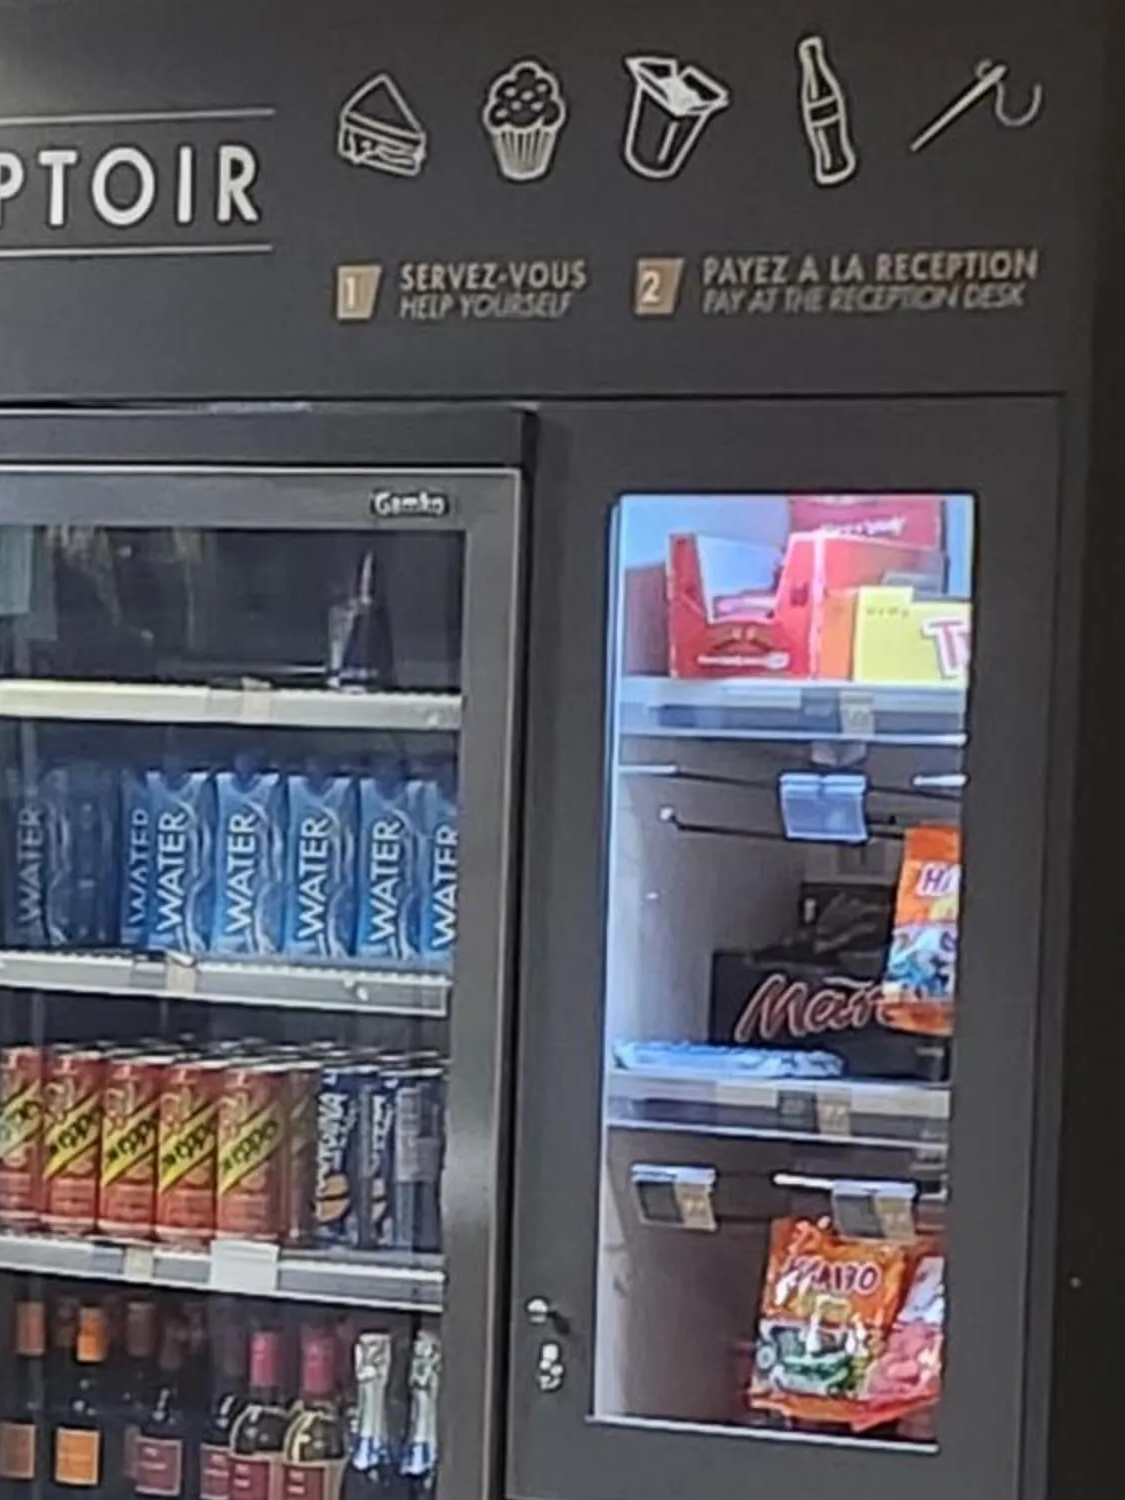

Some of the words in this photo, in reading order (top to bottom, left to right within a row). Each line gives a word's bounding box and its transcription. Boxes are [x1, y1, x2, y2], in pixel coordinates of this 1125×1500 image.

[401, 260, 586, 291] SERVEZ-VOUS
[637, 271, 661, 304] 2
[702, 257, 790, 285] PAYEZ
[797, 255, 821, 283] A
[829, 253, 865, 283] LA
[877, 249, 1039, 282] RECEPTION
[702, 288, 744, 314] PAY
[746, 286, 775, 313] AT
[783, 286, 823, 313] THE
[828, 284, 962, 312] RECEPTION
[962, 282, 1028, 310] DESK
[399, 294, 455, 319] HELP
[459, 292, 573, 319] YOURSELF
[17, 808, 42, 923] WATER
[154, 811, 187, 932] WATER
[225, 813, 255, 933] WATER
[297, 818, 328, 939] WATER
[368, 821, 401, 941] WATER
[734, 973, 890, 1043] Mar
